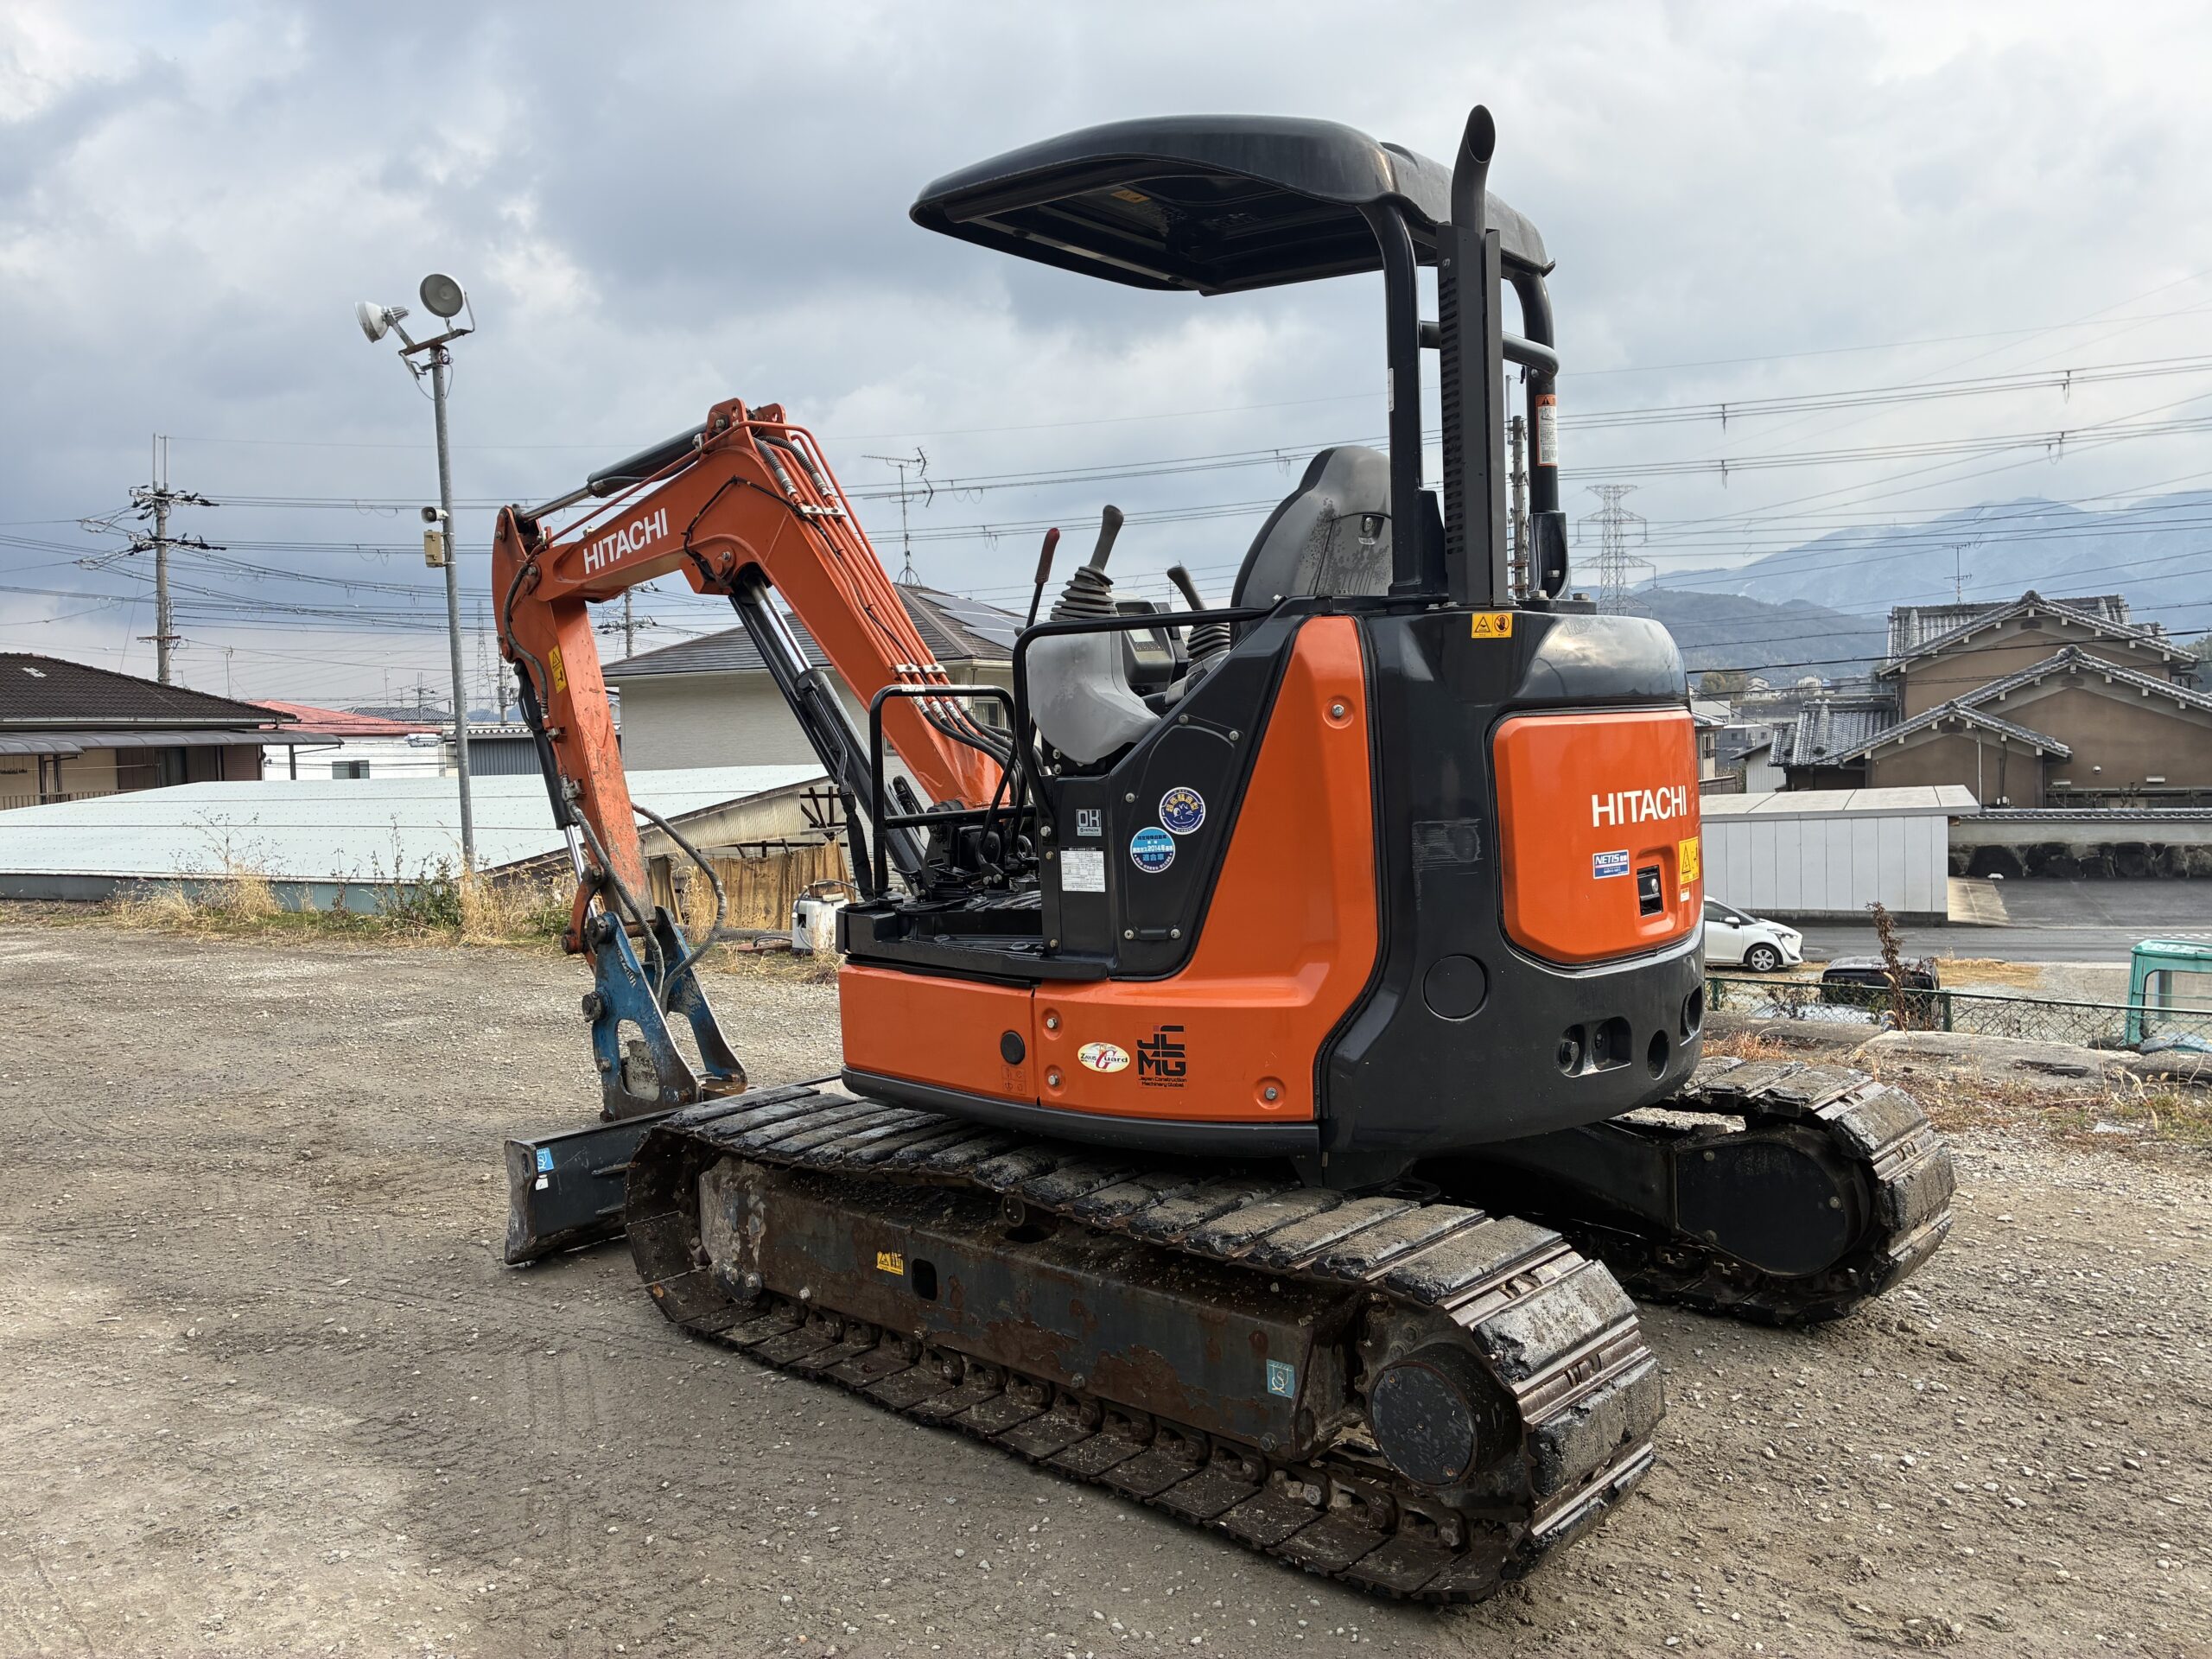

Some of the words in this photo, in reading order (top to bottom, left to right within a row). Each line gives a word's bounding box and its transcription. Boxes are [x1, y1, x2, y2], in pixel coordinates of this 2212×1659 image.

[582, 507, 669, 575] HITACHI
[1591, 785, 1688, 828] HITACHI
[1077, 810, 1100, 827] OK
[1595, 854, 1620, 865] NETIS
[1095, 1049, 1128, 1070] Guard
